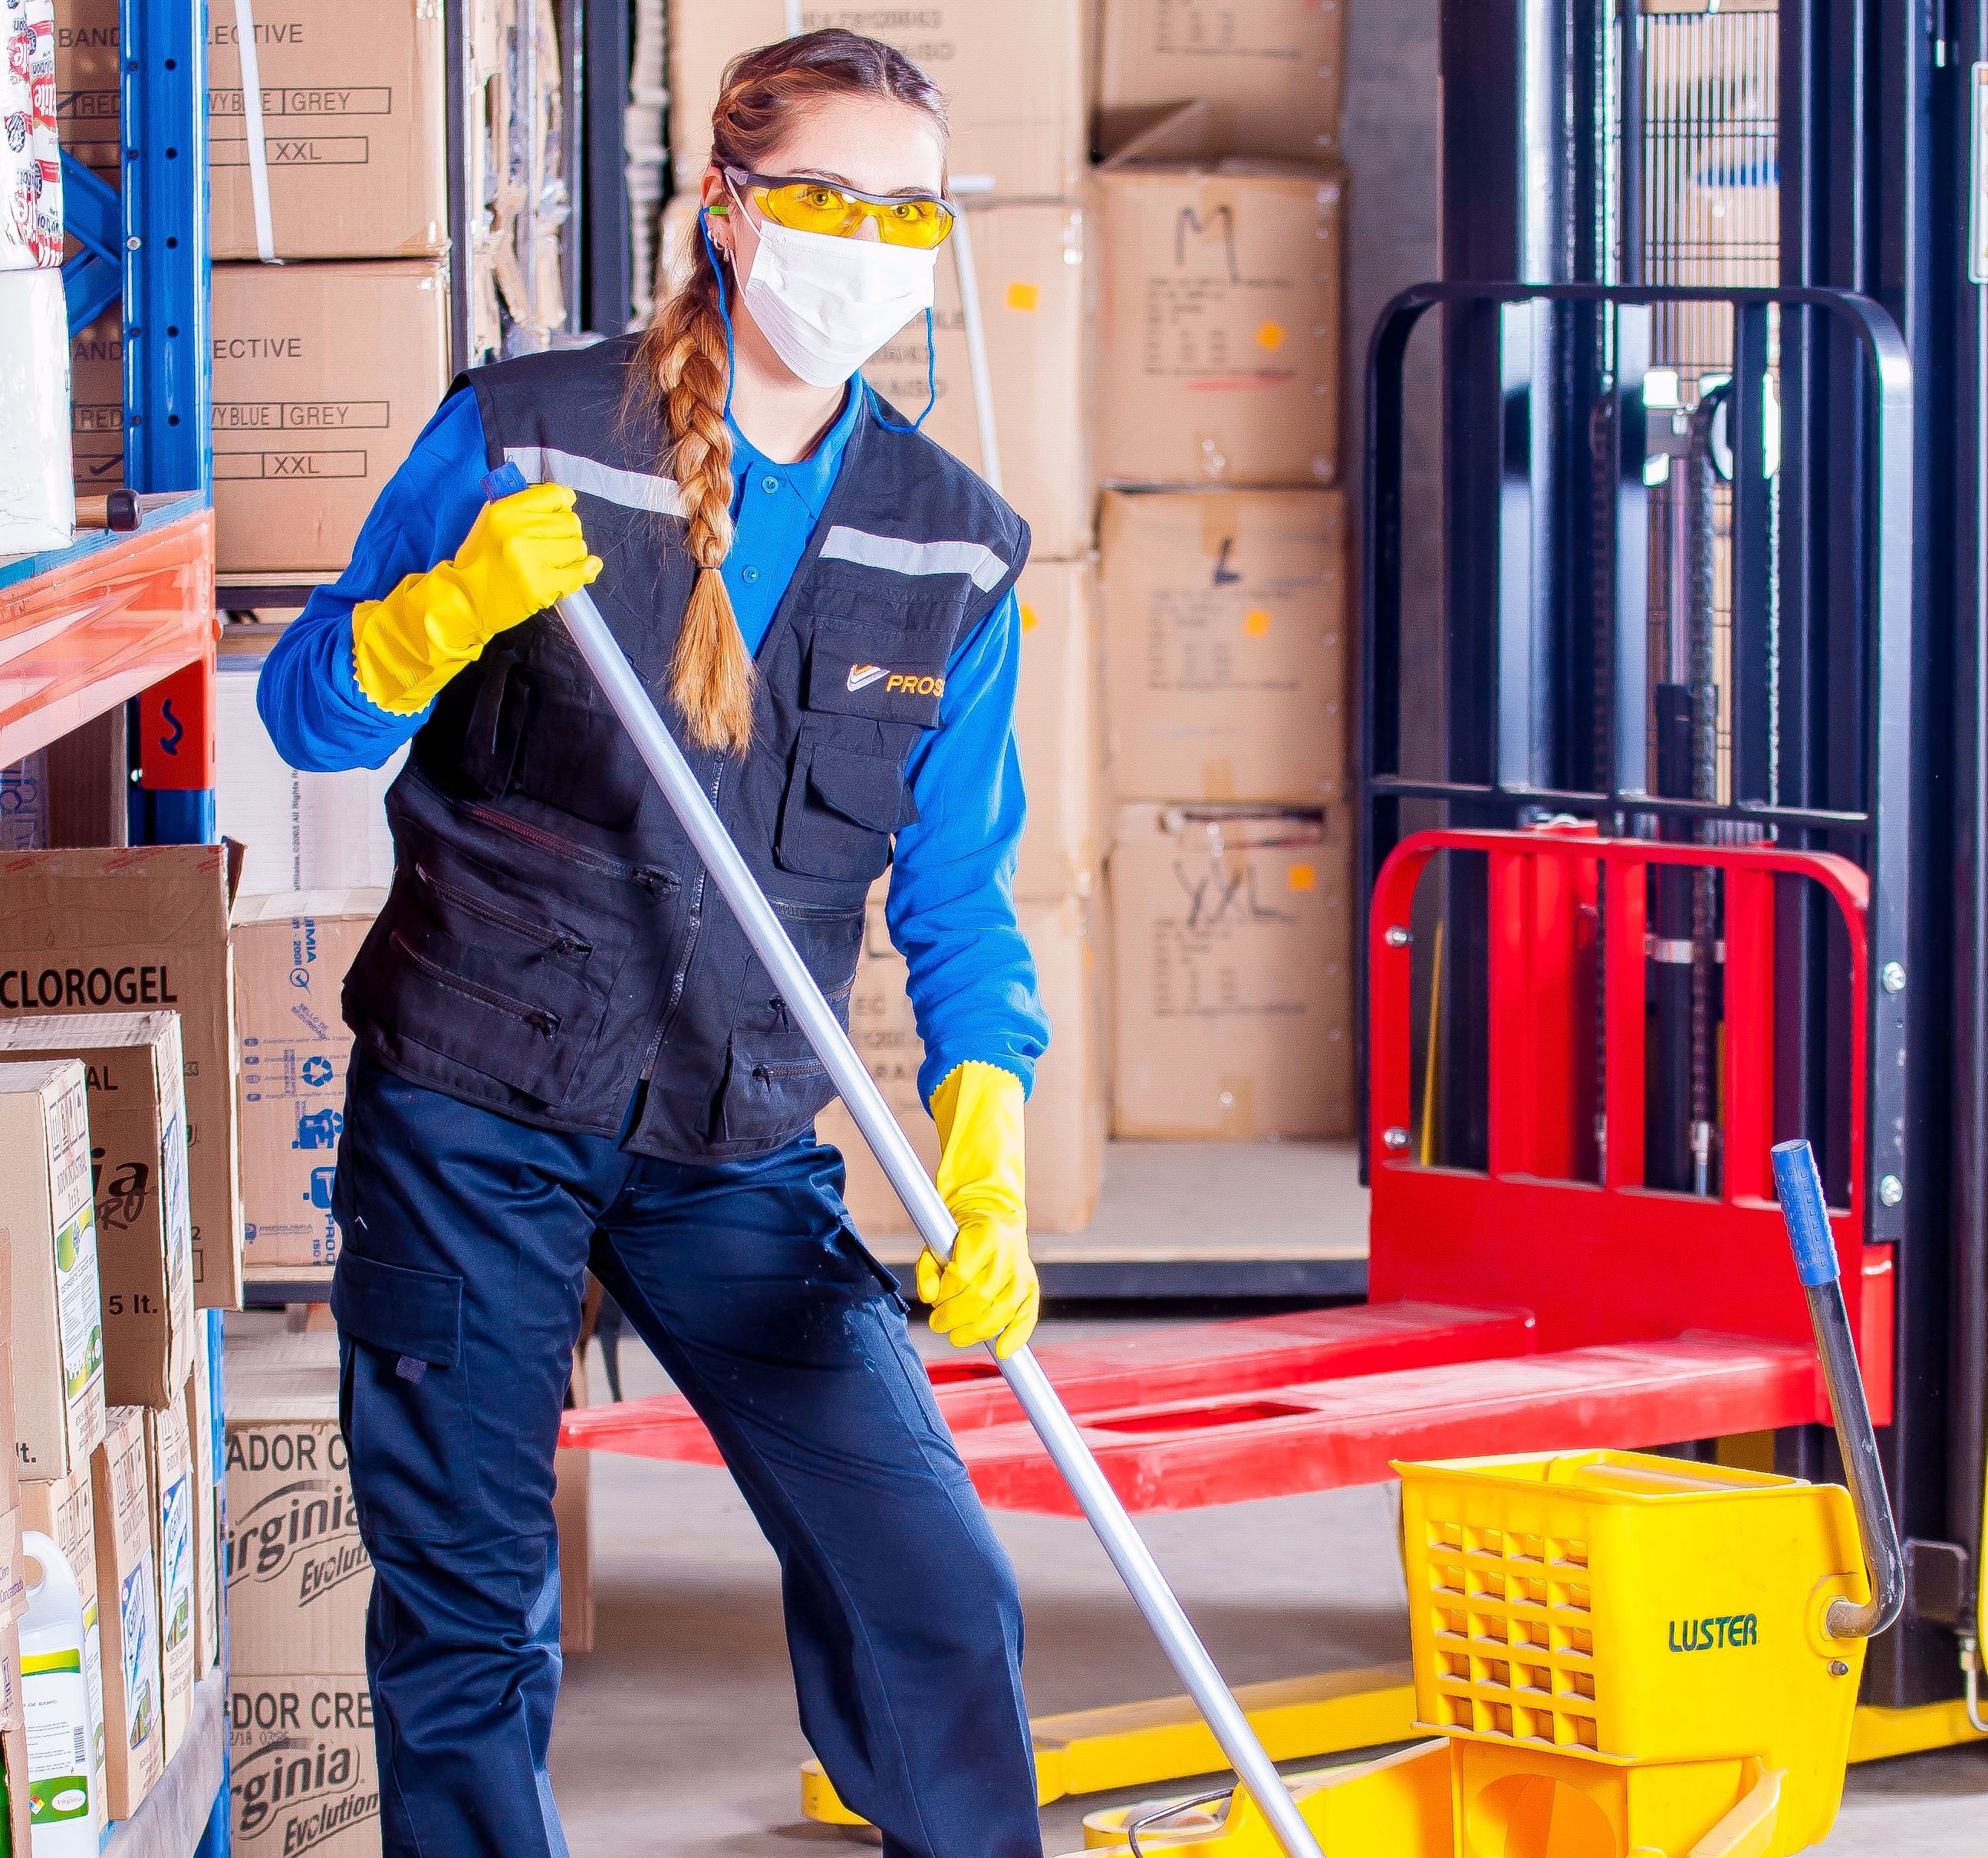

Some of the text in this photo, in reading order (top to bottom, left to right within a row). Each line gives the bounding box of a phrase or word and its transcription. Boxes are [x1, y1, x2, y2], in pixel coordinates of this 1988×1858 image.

[209, 23, 304, 44] ECTIVE
[291, 91, 351, 112] GREY
[275, 141, 322, 161] XXL
[213, 337, 302, 359] ECTIVE
[290, 406, 350, 426] GREY
[274, 455, 321, 475] XXL
[0, 965, 177, 1009] CLOROGEL
[87, 1065, 118, 1090] AL
[108, 1294, 158, 1316] 5 lt.
[1668, 1613, 1757, 1652] LUSTER
[232, 1692, 374, 1730] DOR CRE
